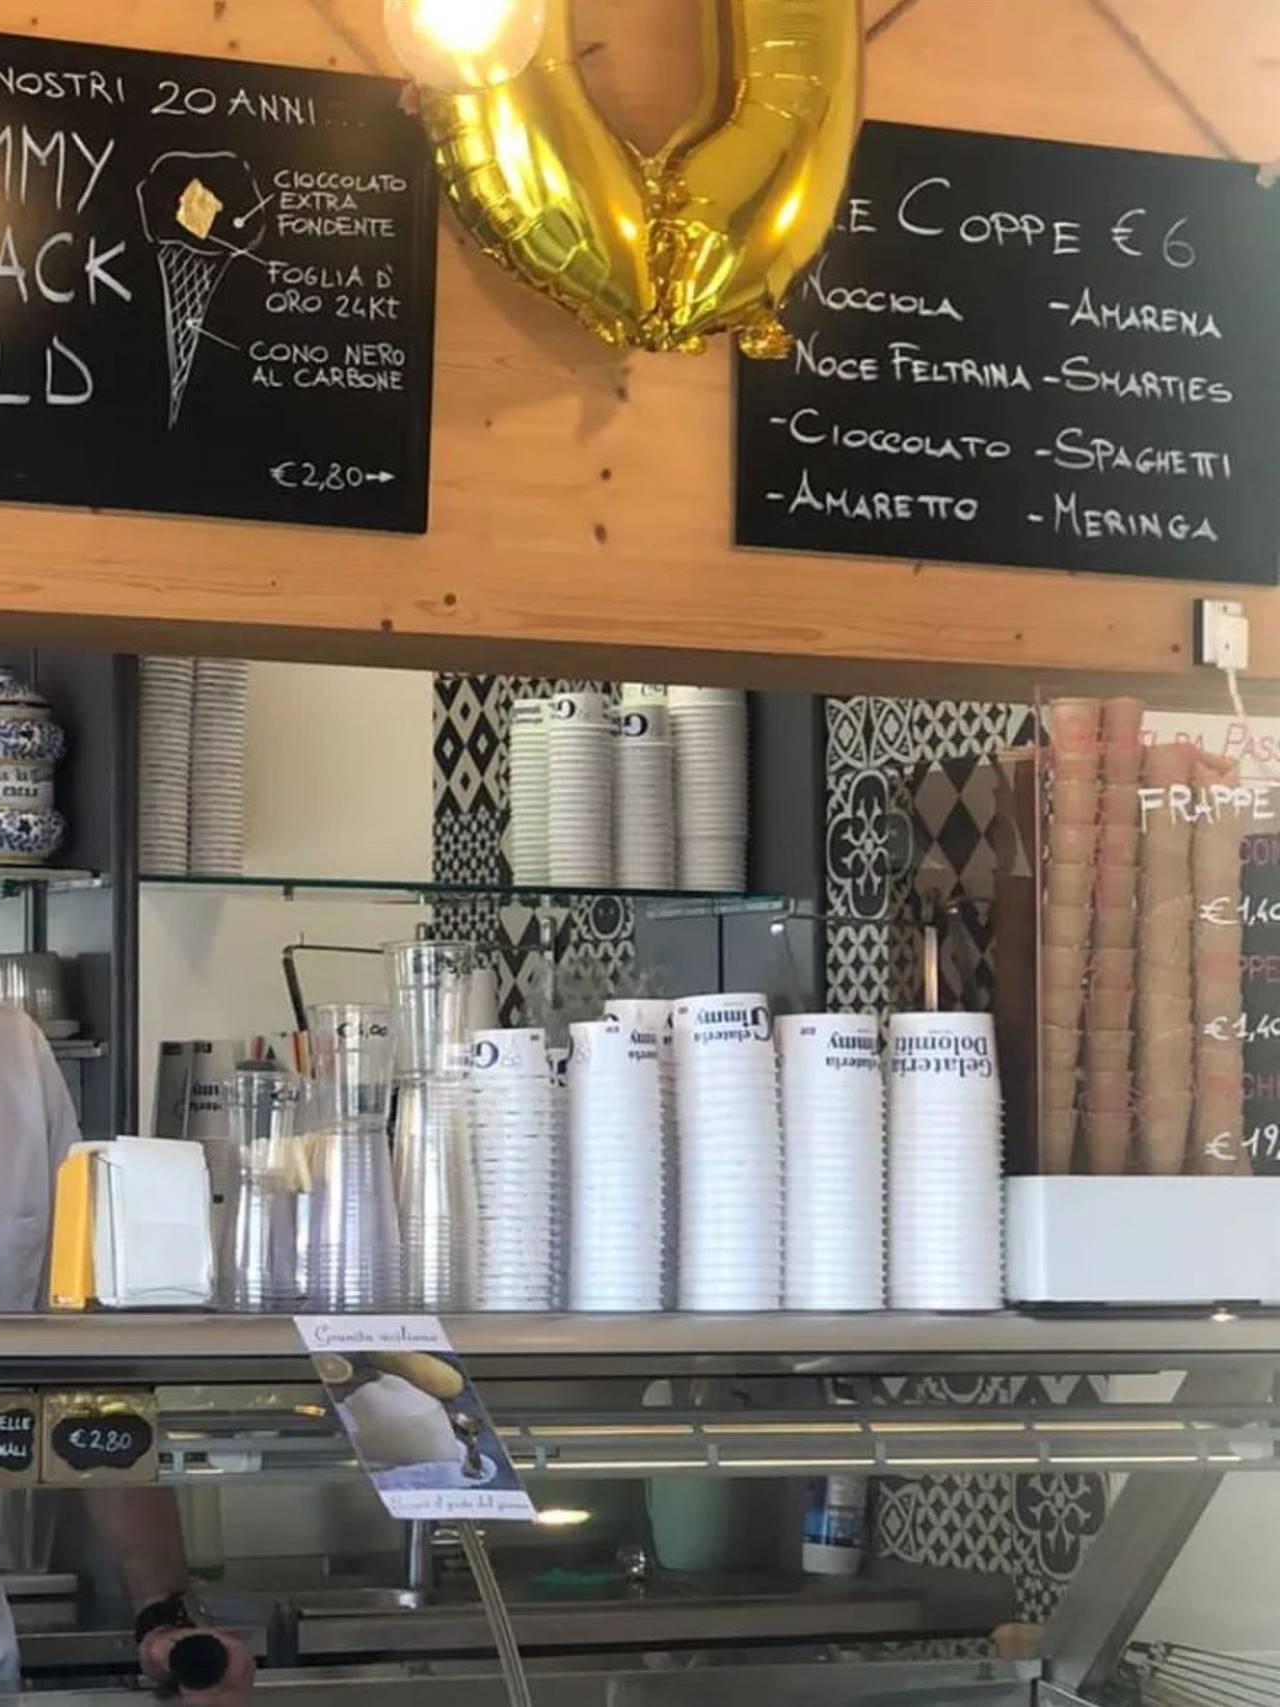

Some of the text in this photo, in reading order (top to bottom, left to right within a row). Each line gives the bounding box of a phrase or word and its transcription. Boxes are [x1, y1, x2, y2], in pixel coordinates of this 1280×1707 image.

[150, 80, 217, 115] 20
[273, 169, 408, 193] CIOCCOLATO
[280, 190, 359, 212] EXTRA
[278, 213, 397, 238] FONDENTE
[836, 177, 1197, 268] E COPPE € 6
[268, 259, 365, 289] FOGLIA
[265, 289, 322, 314] ORO
[249, 340, 406, 367] CONO NERO
[795, 330, 1032, 392] NOCE FELTRINA
[252, 365, 404, 391] AL CARBONE
[269, 460, 363, 492] €2,80
